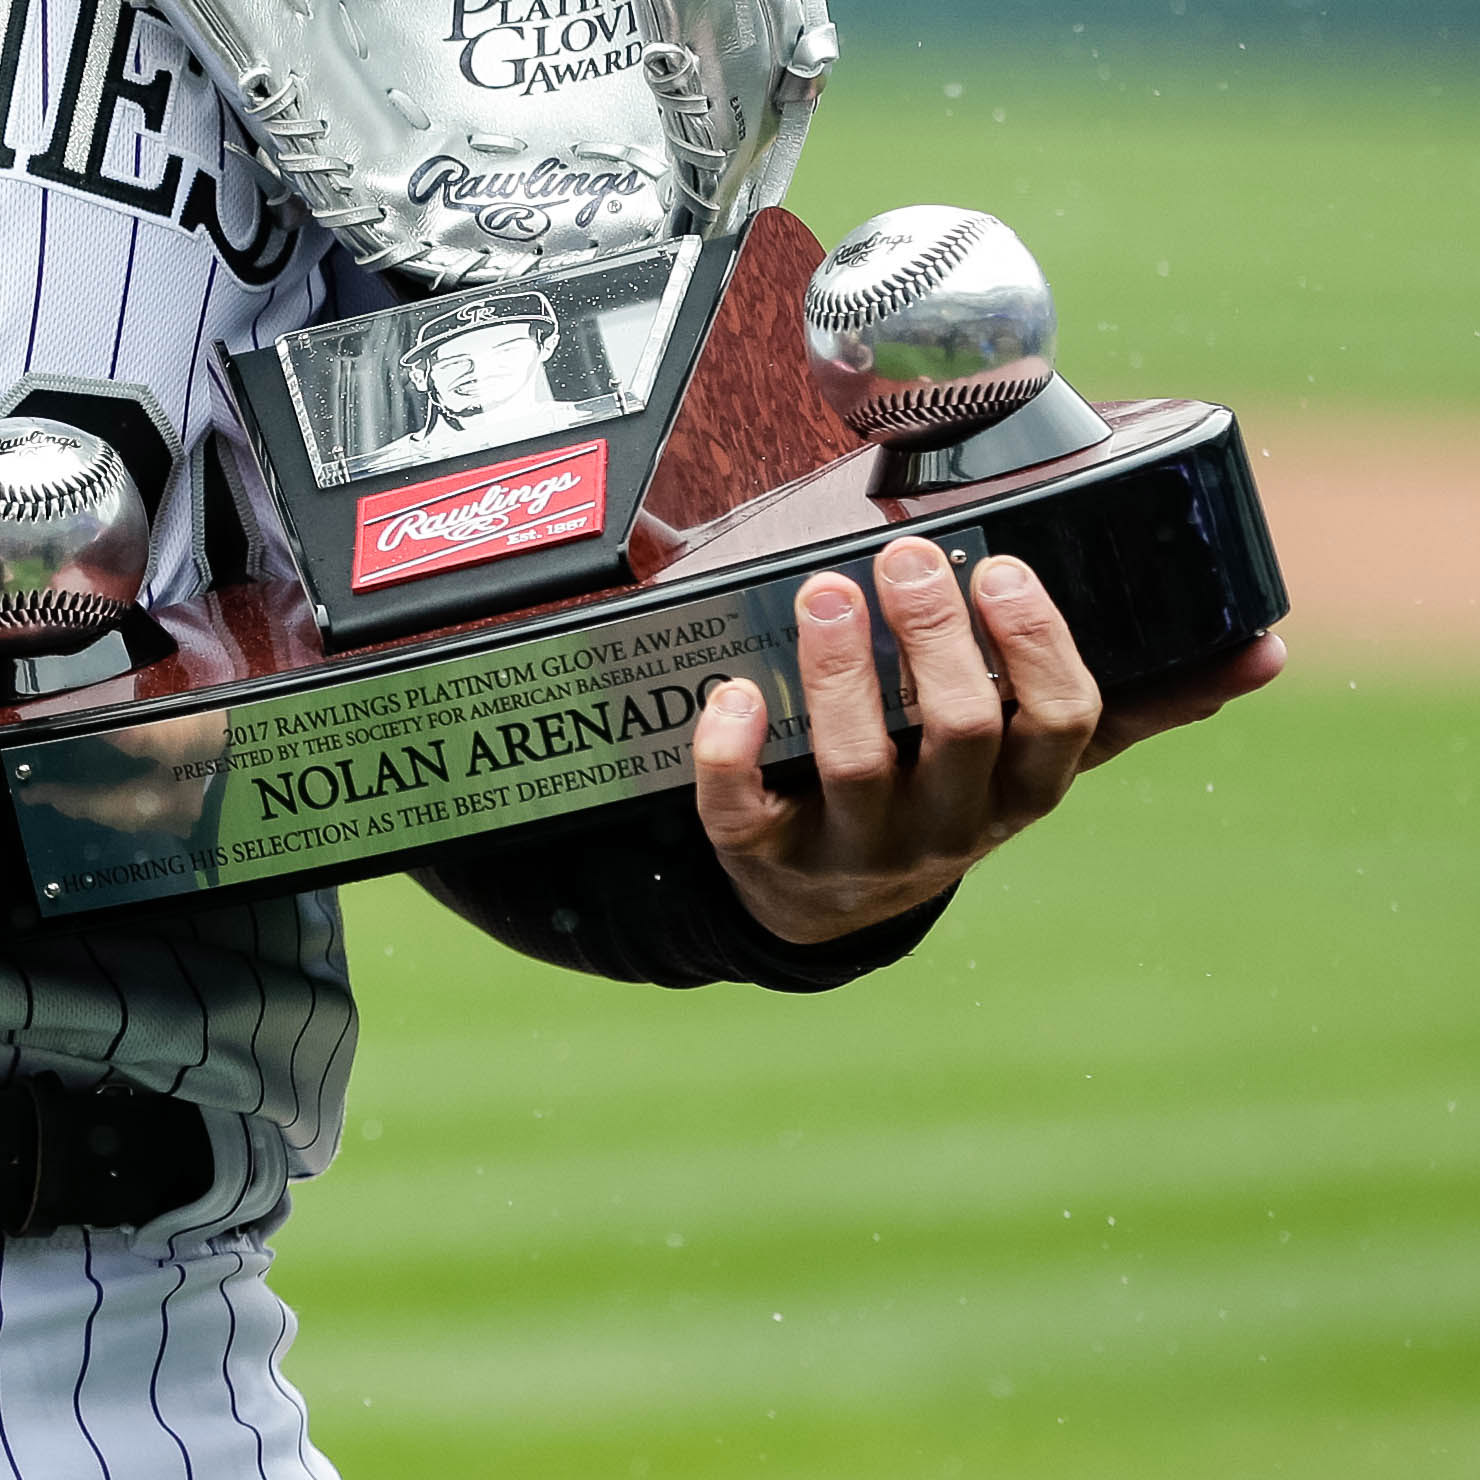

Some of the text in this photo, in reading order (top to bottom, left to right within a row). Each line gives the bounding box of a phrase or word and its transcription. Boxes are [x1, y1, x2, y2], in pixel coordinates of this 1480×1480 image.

[520, 40, 643, 97] AWARD
[407, 154, 646, 229] Rawlings
[825, 232, 914, 274] Rawlings
[376, 471, 582, 553] Rawlings
[505, 516, 589, 547] Est. 1887
[172, 749, 274, 783] PRESENTED
[279, 742, 304, 761] BY
[306, 733, 342, 756] THE
[346, 715, 424, 746] SOCIETY
[428, 704, 467, 728] FOR
[470, 684, 572, 726] AMERICAN
[576, 660, 671, 696] BASEBALL
[674, 632, 781, 671] RESEARCH,
[223, 722, 269, 748] 2017
[276, 694, 401, 737] RAWLINGS
[405, 662, 536, 710] PLATINUM
[541, 640, 627, 679] GLOVE
[60, 854, 185, 896] HONORING
[192, 845, 229, 872] HIS
[232, 819, 360, 864] SELECTION
[366, 811, 395, 837] AS
[397, 798, 450, 829] THE
[455, 784, 511, 818] BEST
[519, 754, 649, 804] DEFENDER
[651, 746, 685, 770] IN
[251, 739, 450, 821] NOLAN
